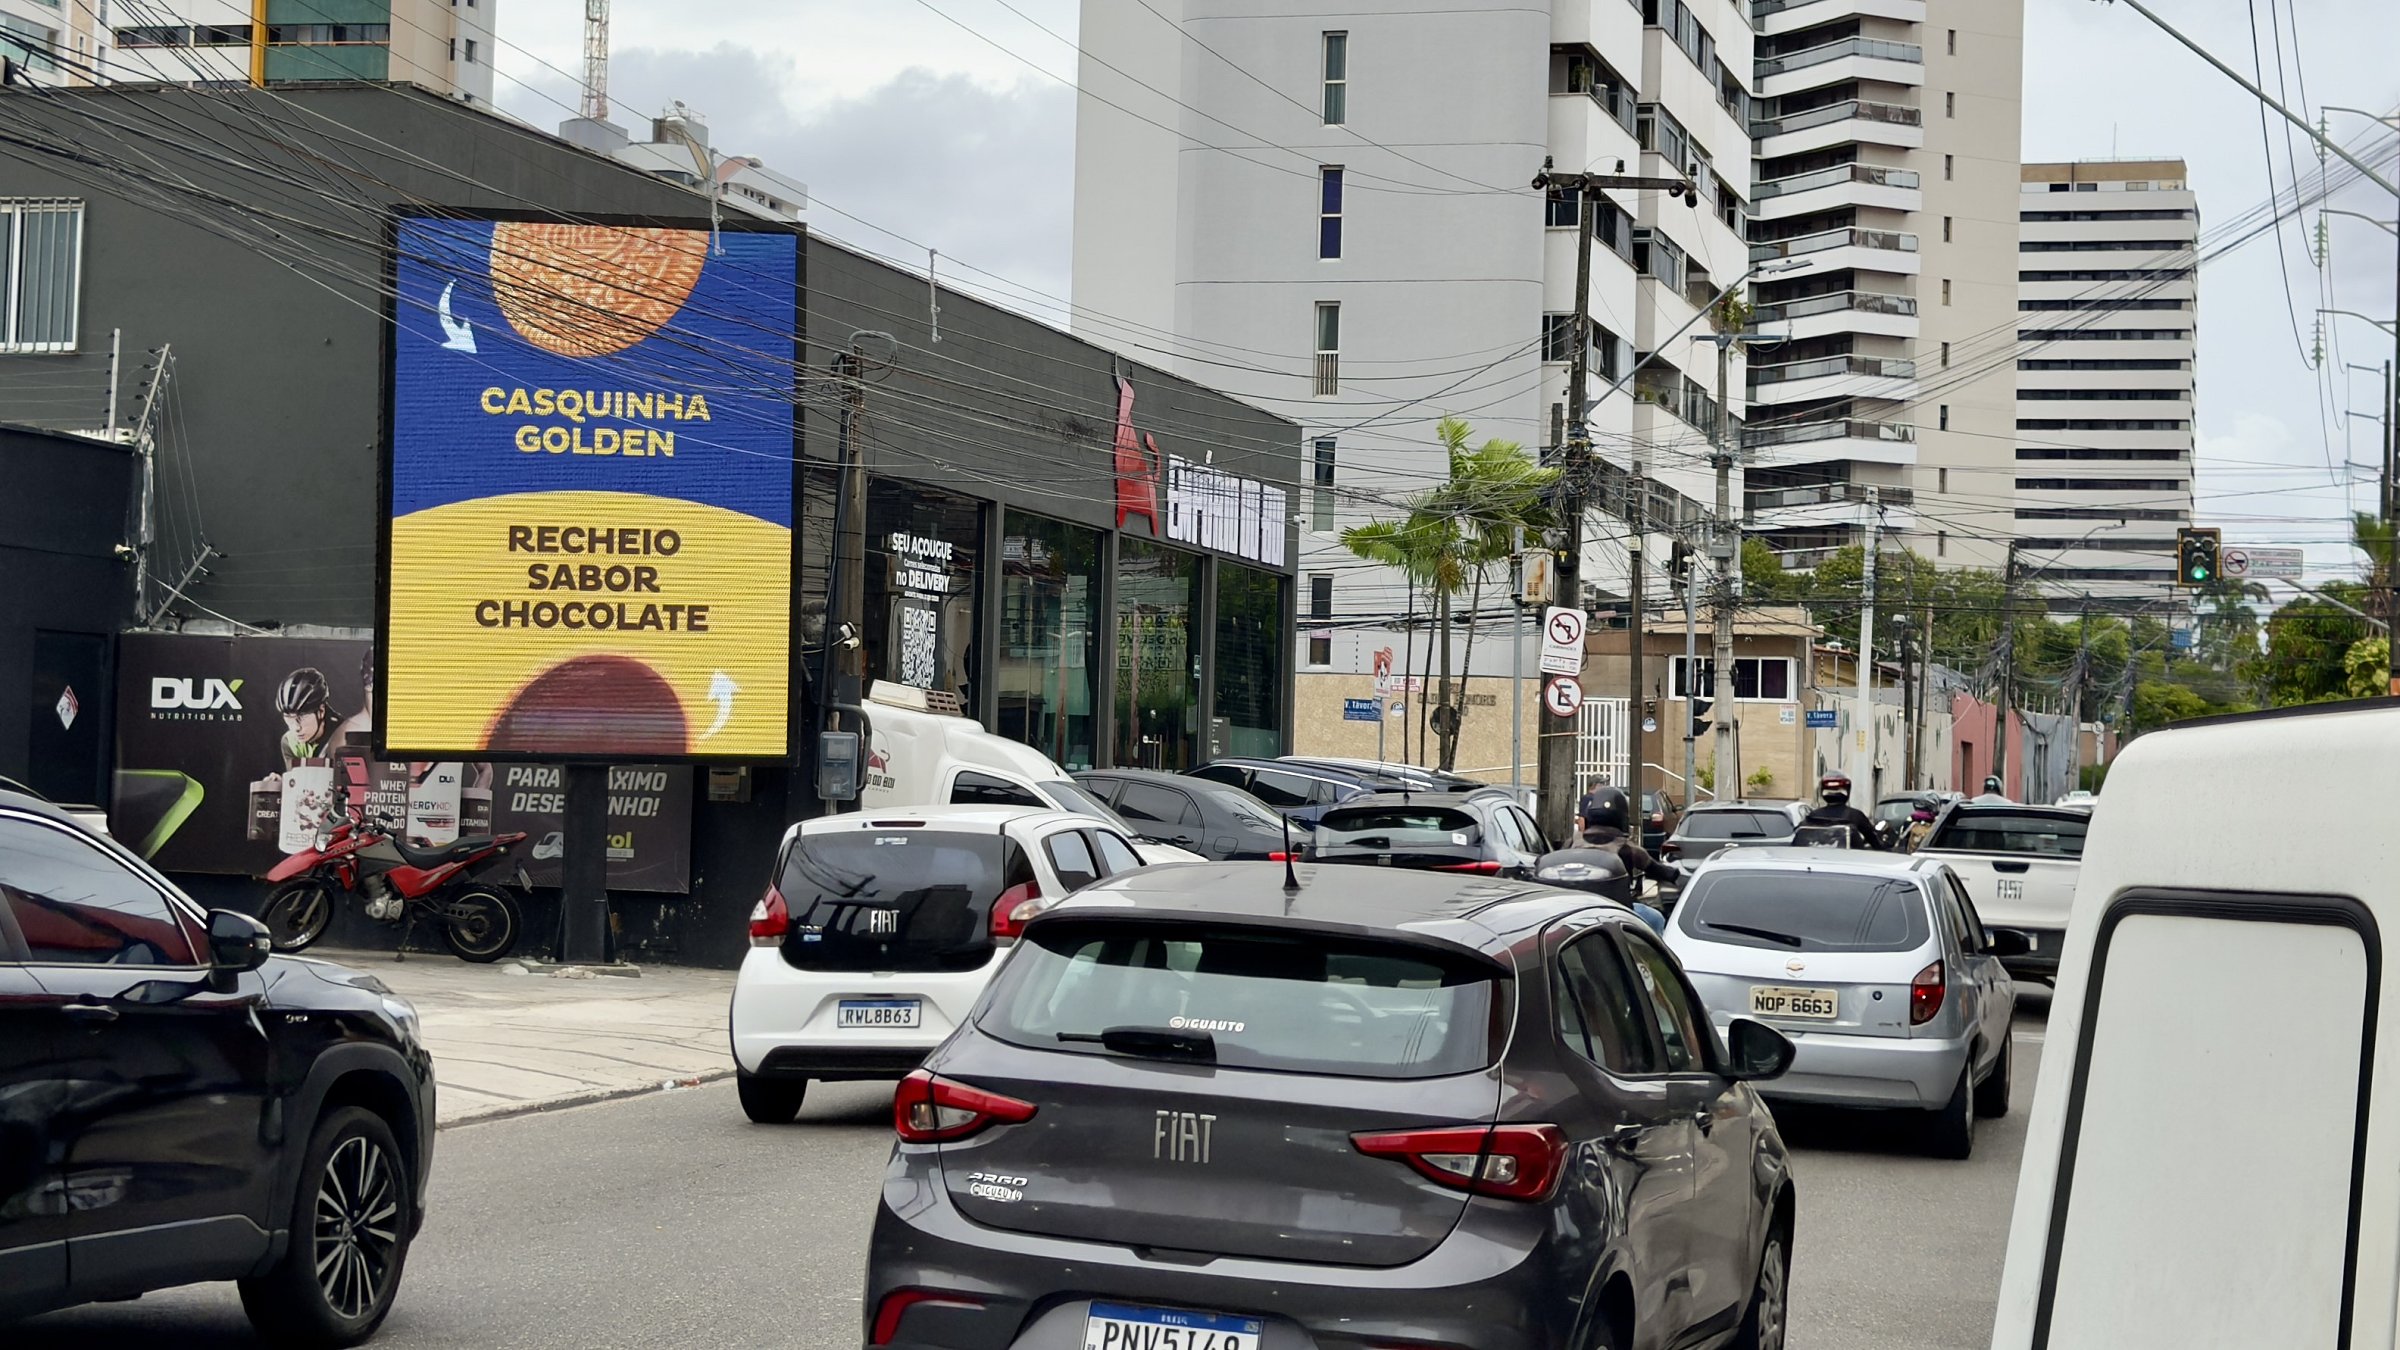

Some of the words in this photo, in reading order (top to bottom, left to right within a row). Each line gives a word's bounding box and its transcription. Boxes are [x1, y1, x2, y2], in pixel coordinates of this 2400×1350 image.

[480, 387, 711, 422] CASQUINHA
[515, 425, 675, 457] GOLDEN
[508, 525, 681, 557] RECHEIO
[892, 532, 910, 553] SEU
[911, 536, 953, 561] AÇOUGUE
[528, 563, 661, 593] SABOR
[896, 571, 907, 586] no
[908, 569, 950, 593] DELIVERY
[475, 600, 710, 632] CHOCOLATE
[151, 677, 244, 710] DUX
[1558, 684, 1572, 707] E
[150, 712, 214, 720] NUTRITION
[380, 780, 407, 791] WHEY
[507, 767, 560, 788] PARA
[608, 766, 668, 791] ÁXIMO
[364, 792, 407, 804] PROTEIN
[365, 804, 406, 817] CONCEN
[1997, 879, 2024, 900] FIAT
[870, 909, 900, 933] FIAT
[845, 1008, 912, 1024] RWL8B63
[1154, 1110, 1217, 1164] FIAT
[967, 1172, 1028, 1187] ARGO
